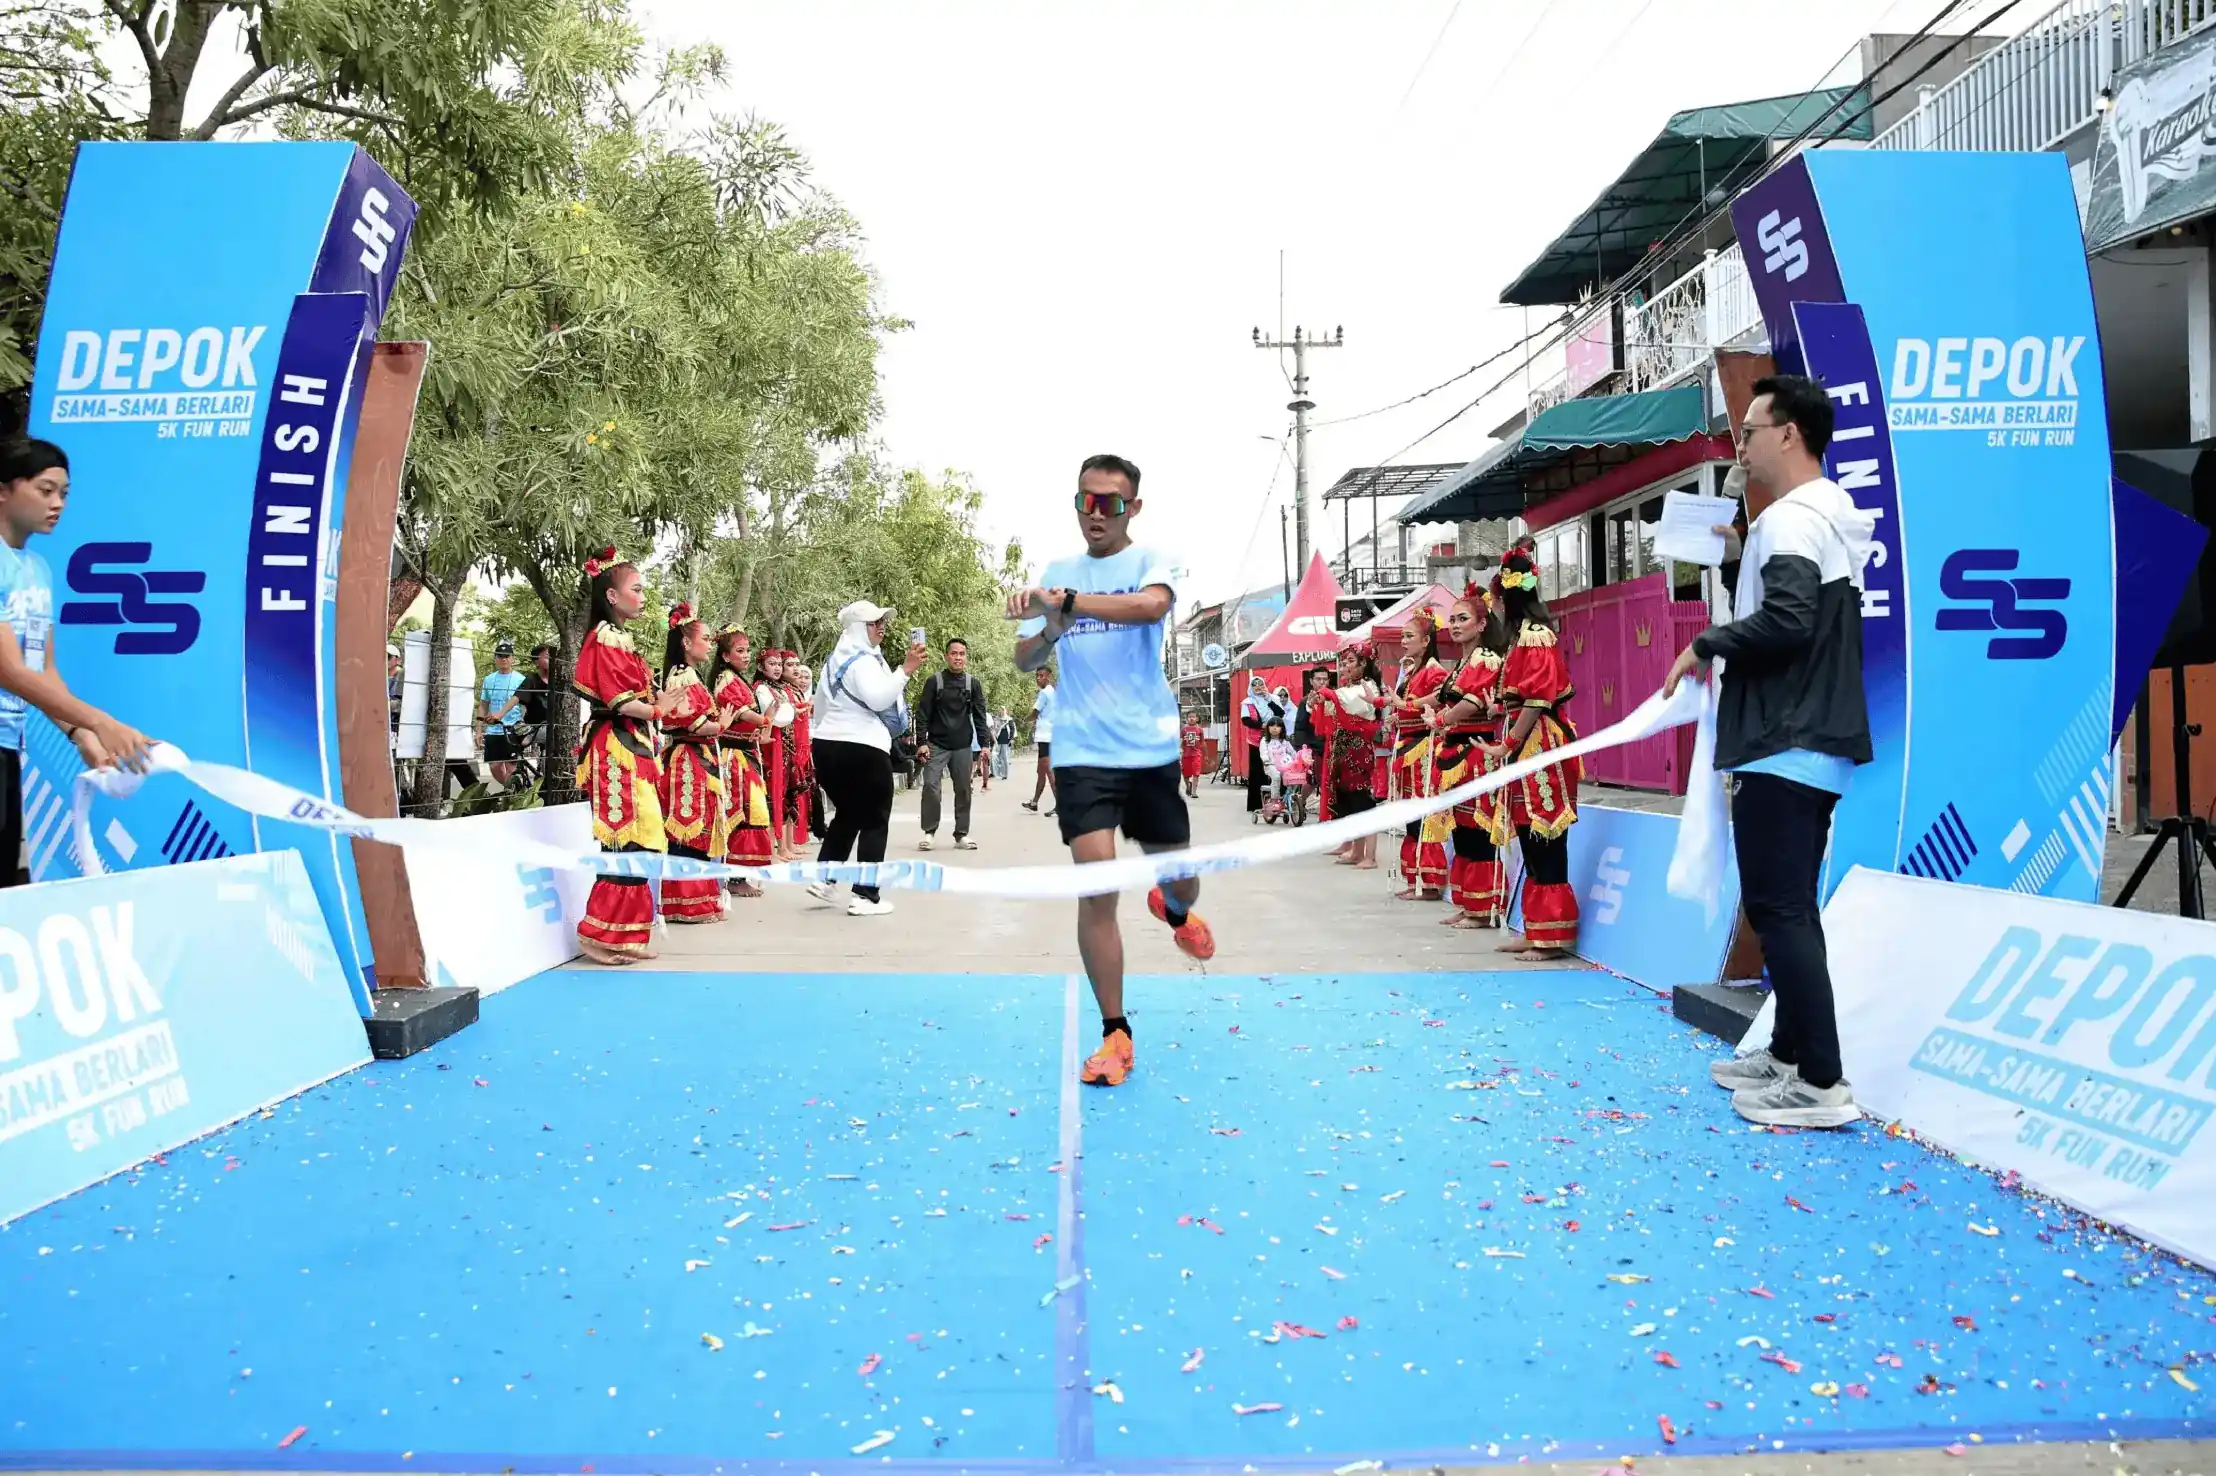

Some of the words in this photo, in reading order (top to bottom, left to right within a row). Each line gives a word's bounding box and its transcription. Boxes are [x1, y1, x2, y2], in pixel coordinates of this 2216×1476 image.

[57, 326, 267, 391] DEPOK
[1890, 336, 2086, 398] DEPOK
[56, 398, 169, 418] SAMA-SAMA
[175, 395, 251, 416] BERLARI
[157, 422, 178, 439] 5K
[183, 421, 212, 438] FUN
[218, 420, 251, 437] RUN
[1891, 406, 1996, 426] SAMA-SAMA
[2003, 405, 2074, 424] BERLARI
[1987, 431, 2006, 447] 5K
[2011, 430, 2040, 446] FUN
[2045, 430, 2075, 446] RUN
[261, 374, 328, 611] FINISH
[74, 1031, 172, 1099] BERLARI
[1920, 1035, 2066, 1104] SAMA-SAMA
[2063, 1077, 2200, 1146] BERLARI
[66, 1111, 100, 1152] 5K
[102, 1094, 146, 1138] FUN
[148, 1073, 190, 1117] RUN
[2016, 1116, 2055, 1151] 5K
[2051, 1127, 2111, 1169] FUN
[2103, 1146, 2173, 1192] RUN
